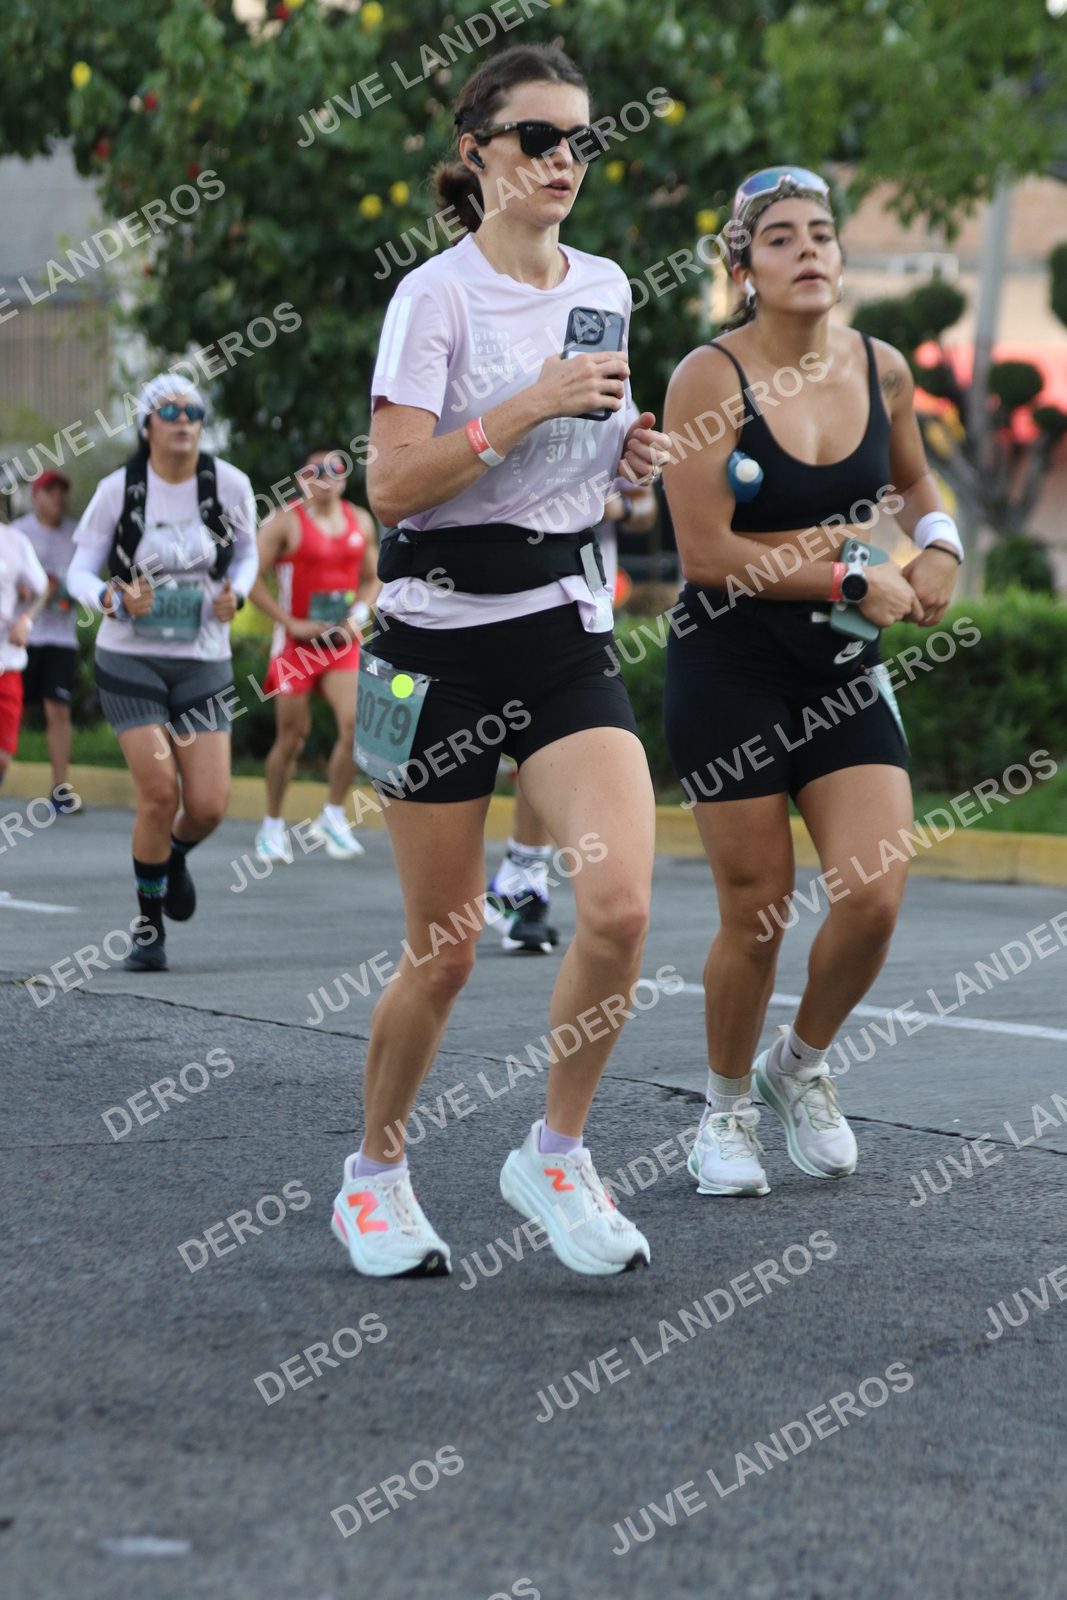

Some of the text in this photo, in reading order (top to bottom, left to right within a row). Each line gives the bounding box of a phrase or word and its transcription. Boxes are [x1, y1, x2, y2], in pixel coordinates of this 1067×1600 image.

[549, 418, 570, 437] 15
[571, 417, 597, 460] K
[545, 442, 567, 464] 30
